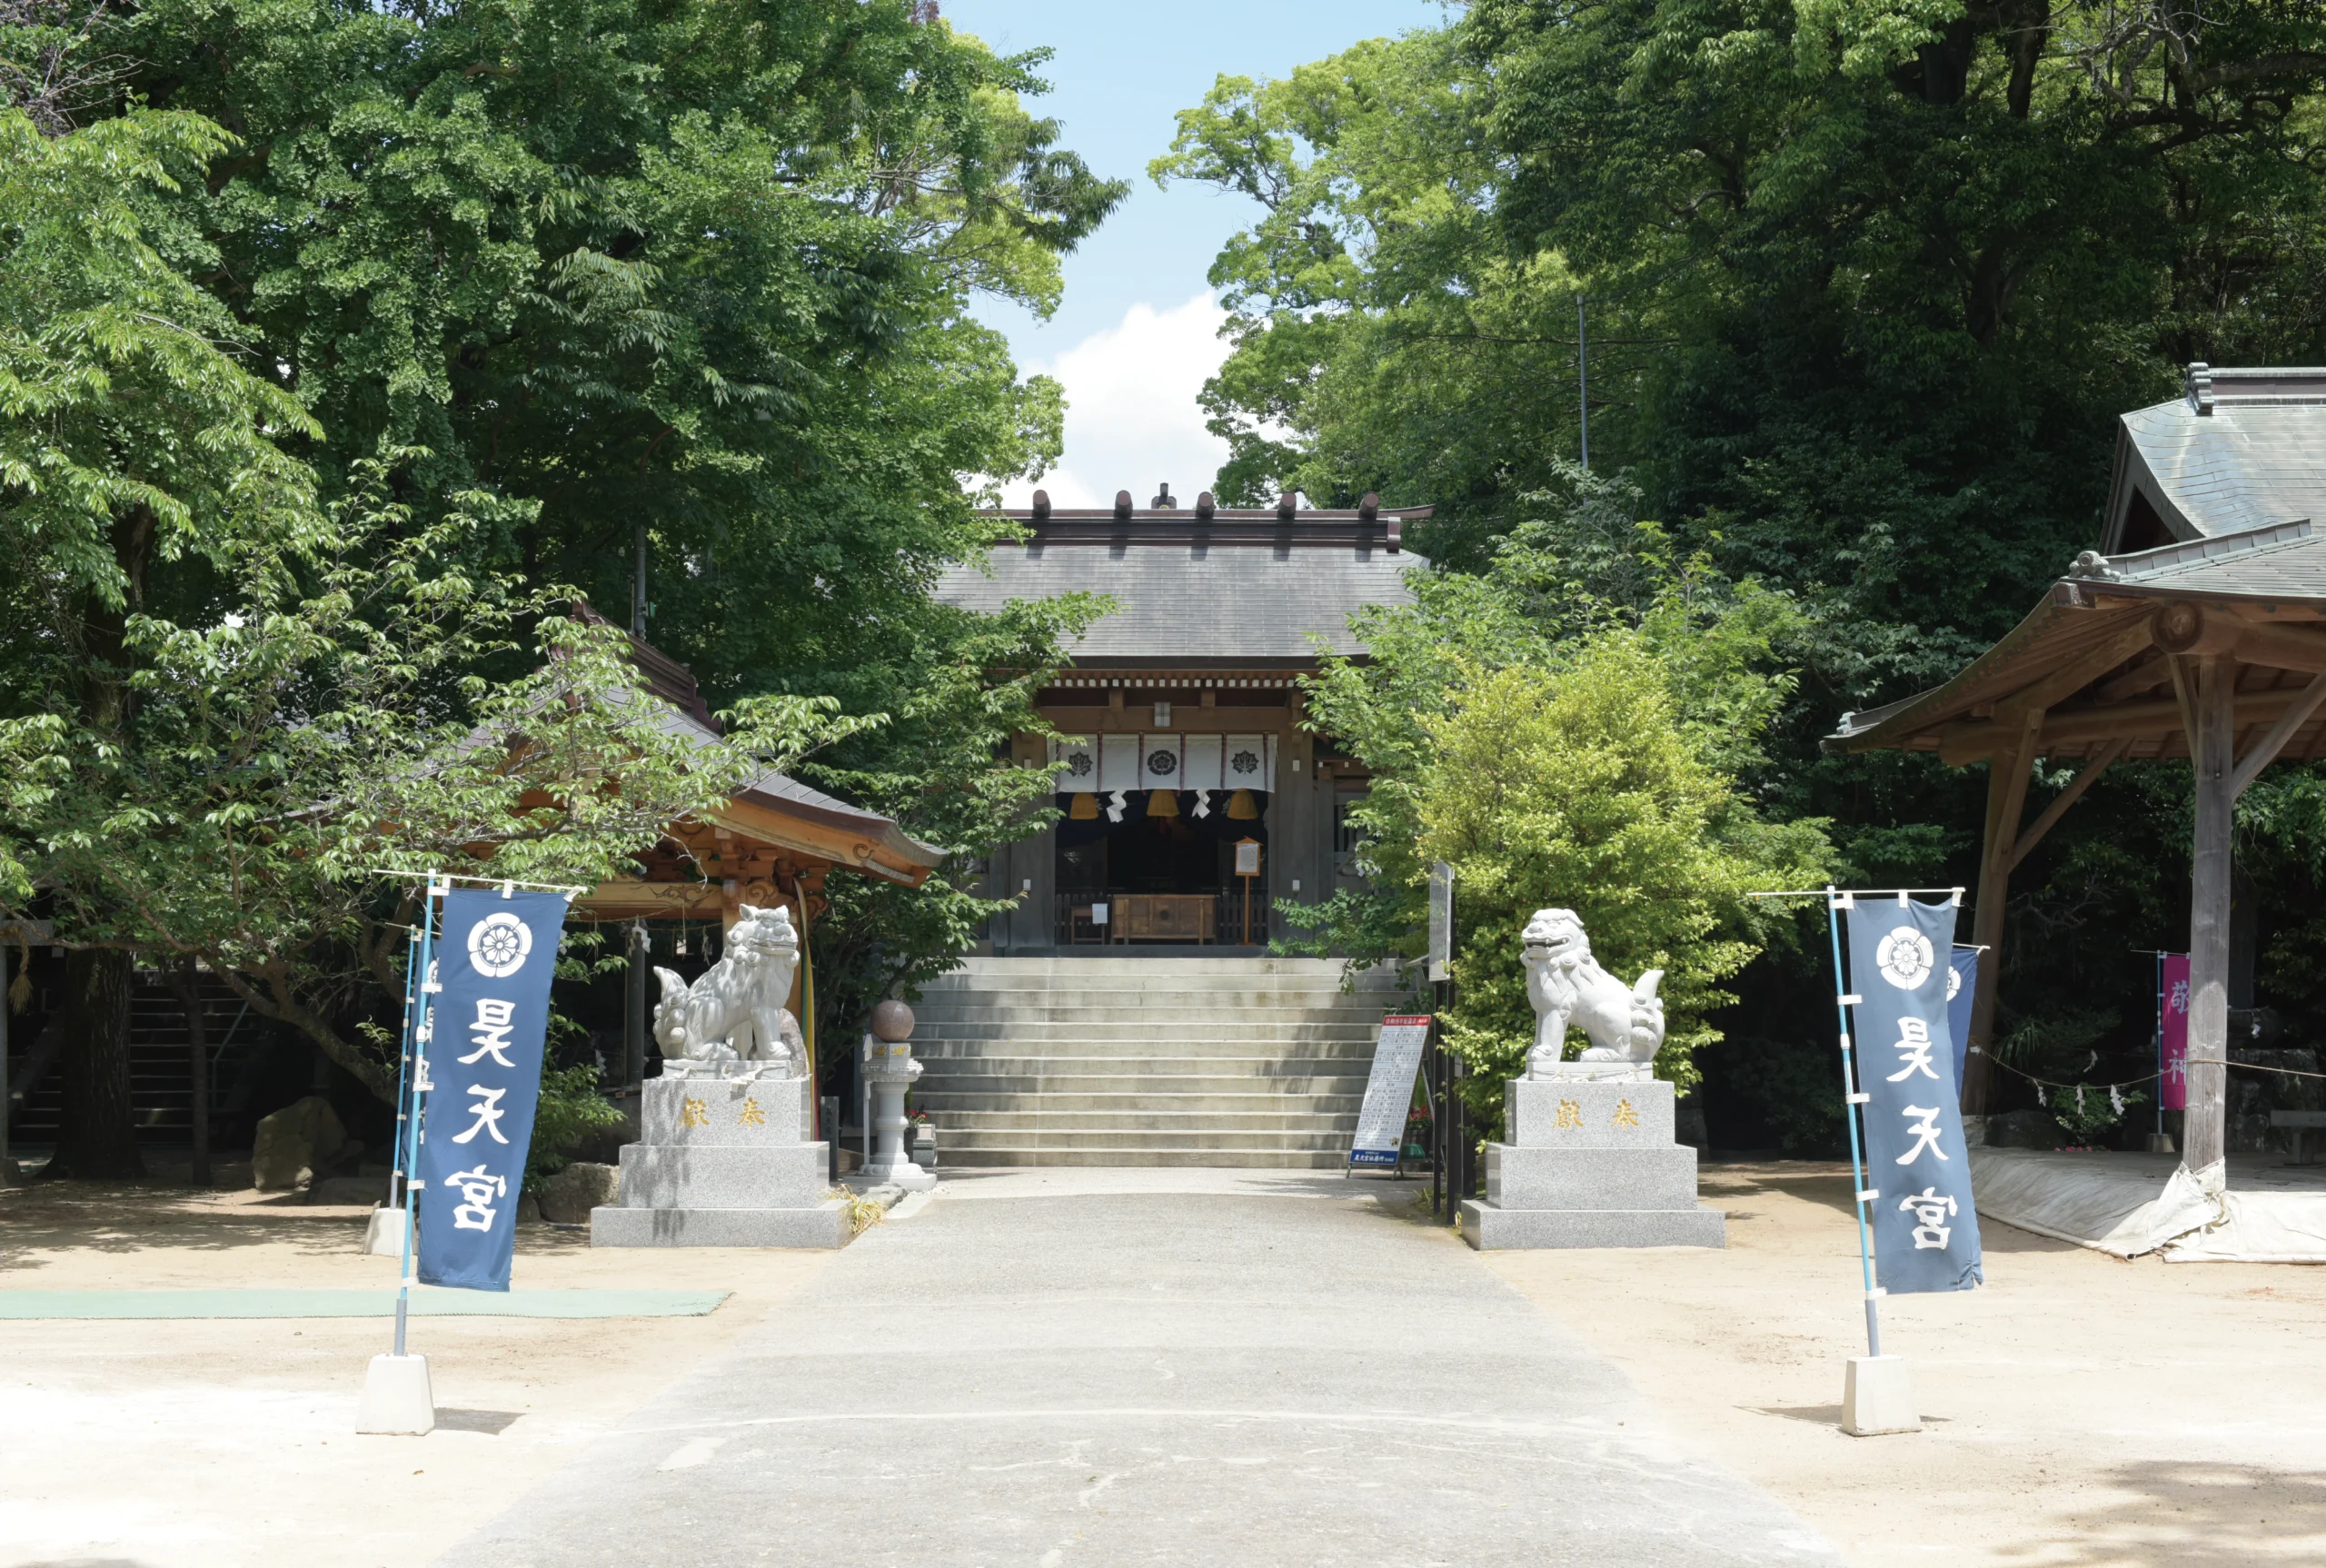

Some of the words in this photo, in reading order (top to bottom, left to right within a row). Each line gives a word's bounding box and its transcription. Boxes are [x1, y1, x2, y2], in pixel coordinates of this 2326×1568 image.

[444, 997, 516, 1233] 昊天宮
[1886, 1016, 1958, 1250] 昊天宮
